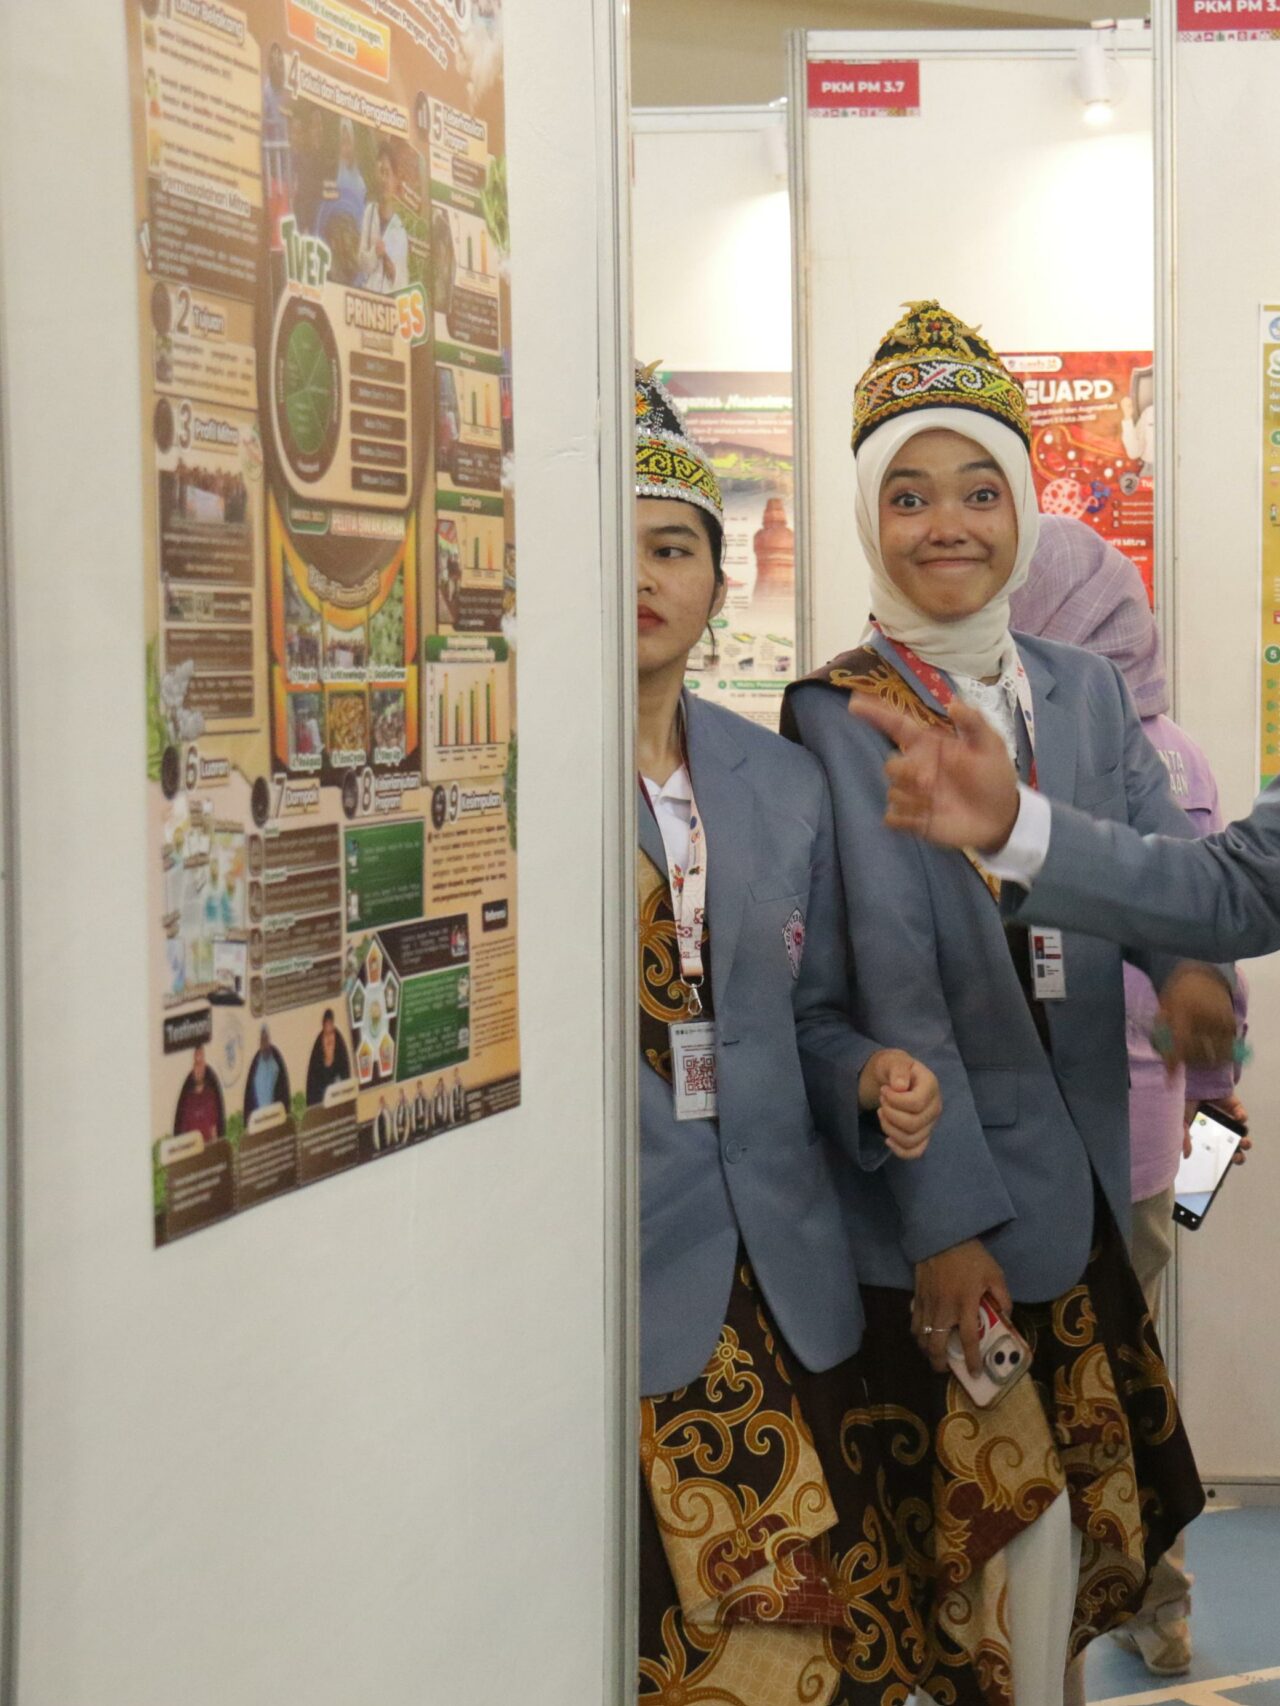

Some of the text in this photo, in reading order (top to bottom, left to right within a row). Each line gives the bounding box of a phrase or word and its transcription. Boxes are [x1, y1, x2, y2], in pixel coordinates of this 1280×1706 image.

[1194, 0, 1232, 13] PKM
[1237, 0, 1263, 12] PM
[290, 51, 300, 100] 4
[822, 81, 905, 93] PKM PM 3.7
[432, 102, 442, 143] 5
[177, 287, 190, 335] 2
[346, 286, 425, 345] PRINSIP 5S
[1024, 379, 1114, 405] GUARD
[179, 401, 191, 450] 3
[1125, 479, 1133, 489] 2
[185, 745, 198, 791] 6
[274, 776, 286, 819] 7
[362, 770, 372, 812] 8
[449, 785, 459, 822] 9
